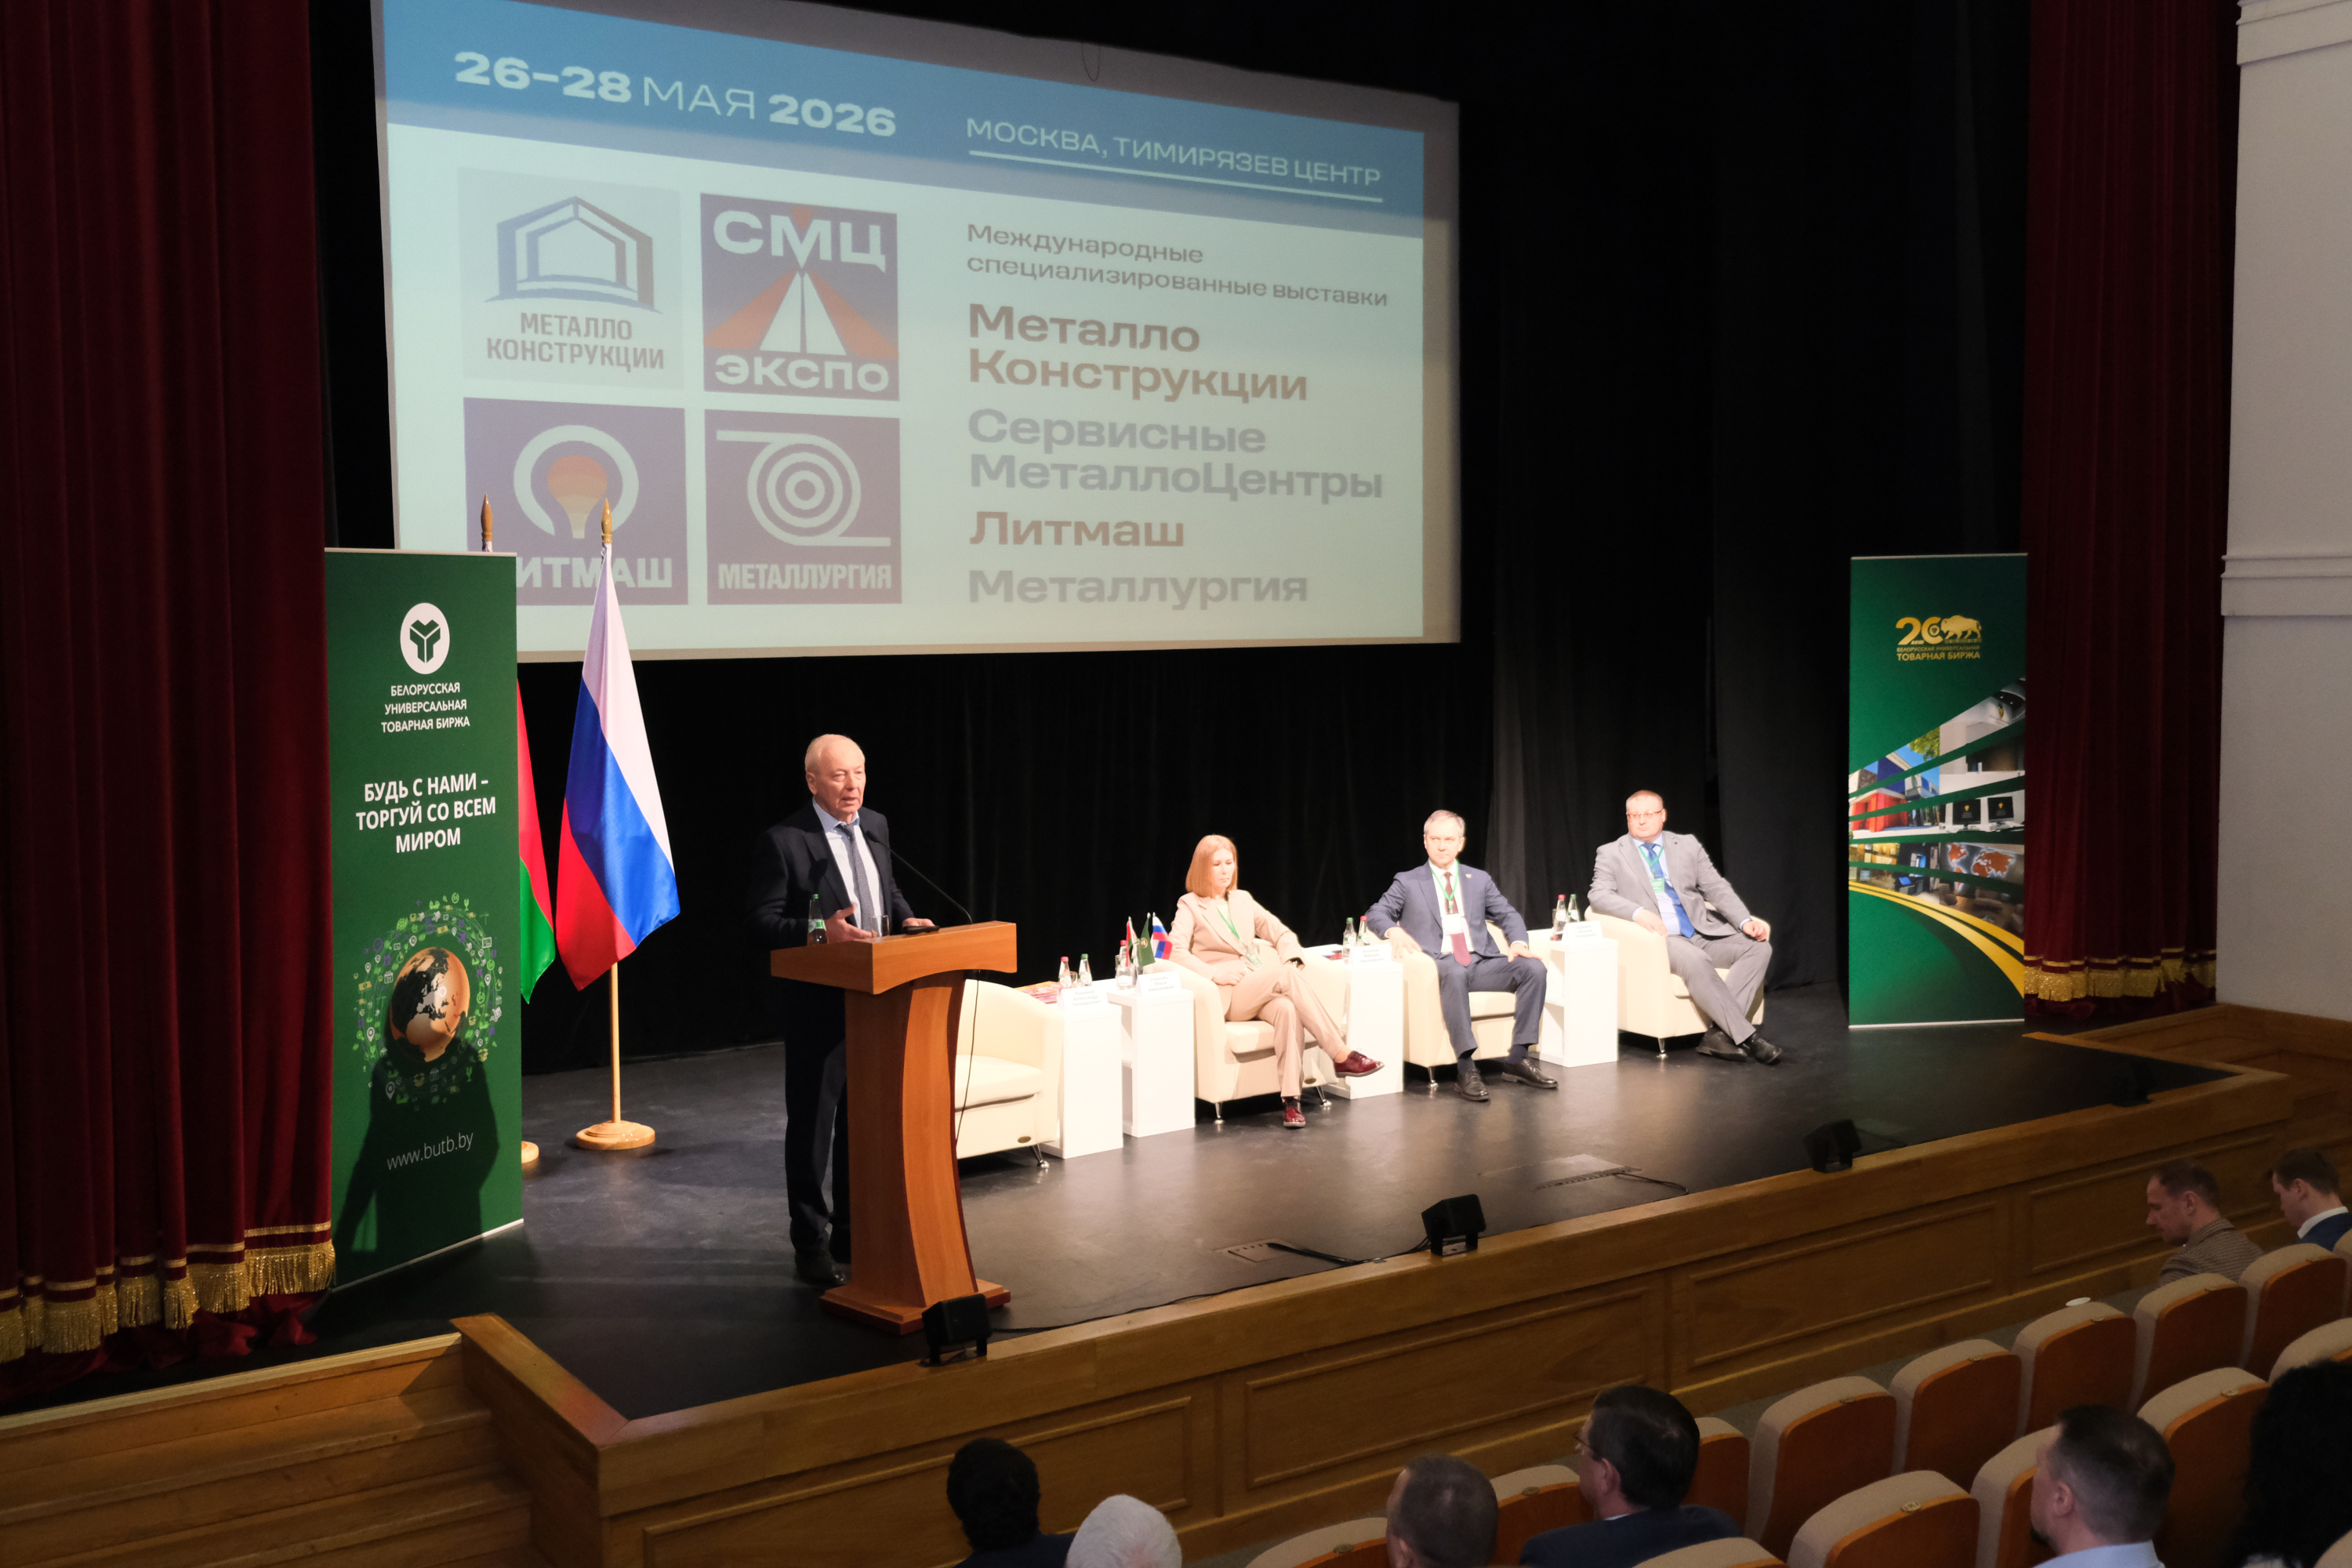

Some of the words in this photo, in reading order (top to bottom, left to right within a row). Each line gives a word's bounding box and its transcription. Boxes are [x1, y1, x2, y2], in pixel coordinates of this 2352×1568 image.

[642, 76, 756, 120] МАЯ
[768, 93, 897, 138] 2026
[966, 117, 1108, 158] МОСКВА,
[1113, 136, 1288, 178] ТИМИРЯЗЕВ
[1294, 159, 1381, 187] ЦЕНТР
[713, 209, 887, 274] СМЦ
[967, 223, 1204, 266] Международные
[967, 254, 1268, 298] специализированные
[1272, 284, 1388, 307] выставки
[520, 311, 633, 341] МЕТАЛЛО
[968, 302, 1201, 354] Металло
[486, 337, 665, 373] КОНСТРУКЦИИ
[714, 354, 891, 393] ЭКСПО
[968, 347, 1308, 404] Конструкции
[967, 407, 1267, 455] Сервисные
[969, 452, 1383, 504] МеталлоЦентры
[969, 510, 1184, 547] Литмаш
[516, 557, 673, 588] ИТМАШ
[718, 563, 892, 590] МЕТАЛЛУРГИЯ
[968, 570, 1308, 611] Металлургия
[1896, 652, 1945, 661] ТОВАРНАЯ
[1947, 651, 1980, 660] БИРЖА
[384, 699, 467, 715] УНИВЕРСАЛЬНАЯ
[390, 681, 461, 697] БЕЛОРУССКАЯ
[381, 717, 434, 733] ТОВАРНАЯ
[436, 716, 470, 729] БИРЖА
[364, 781, 408, 804] БУДЬ
[412, 779, 423, 797] С
[427, 772, 477, 795] НАМИ
[355, 800, 423, 830] ТОРГУЙ
[426, 801, 449, 822] СО
[453, 797, 496, 819] ВСЕМ
[395, 827, 461, 854] МИРОМ
[387, 1132, 474, 1171] www.butb.by
